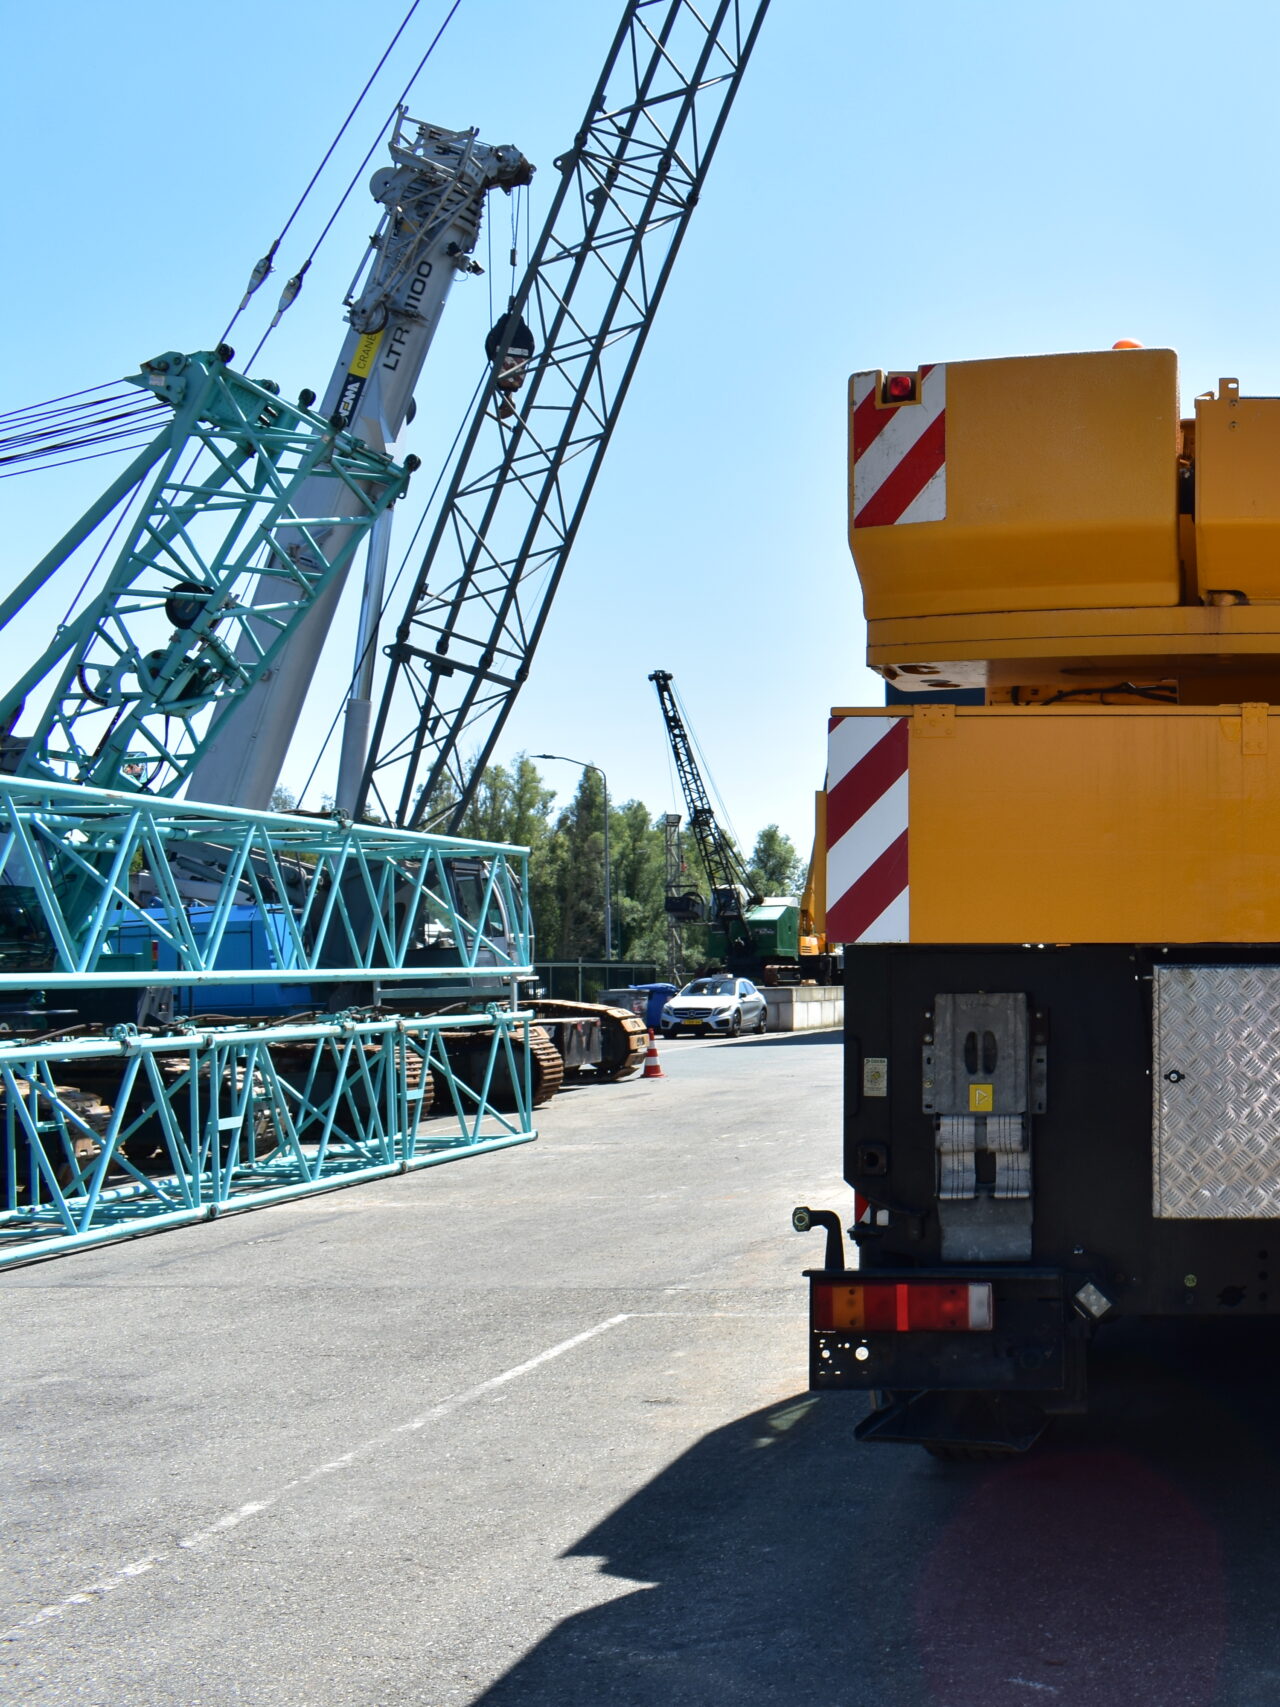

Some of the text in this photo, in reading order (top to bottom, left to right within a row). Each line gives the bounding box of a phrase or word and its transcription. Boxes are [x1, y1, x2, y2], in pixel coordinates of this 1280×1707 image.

[357, 333, 377, 369] CRANE
[383, 260, 433, 372] LTR 1100
